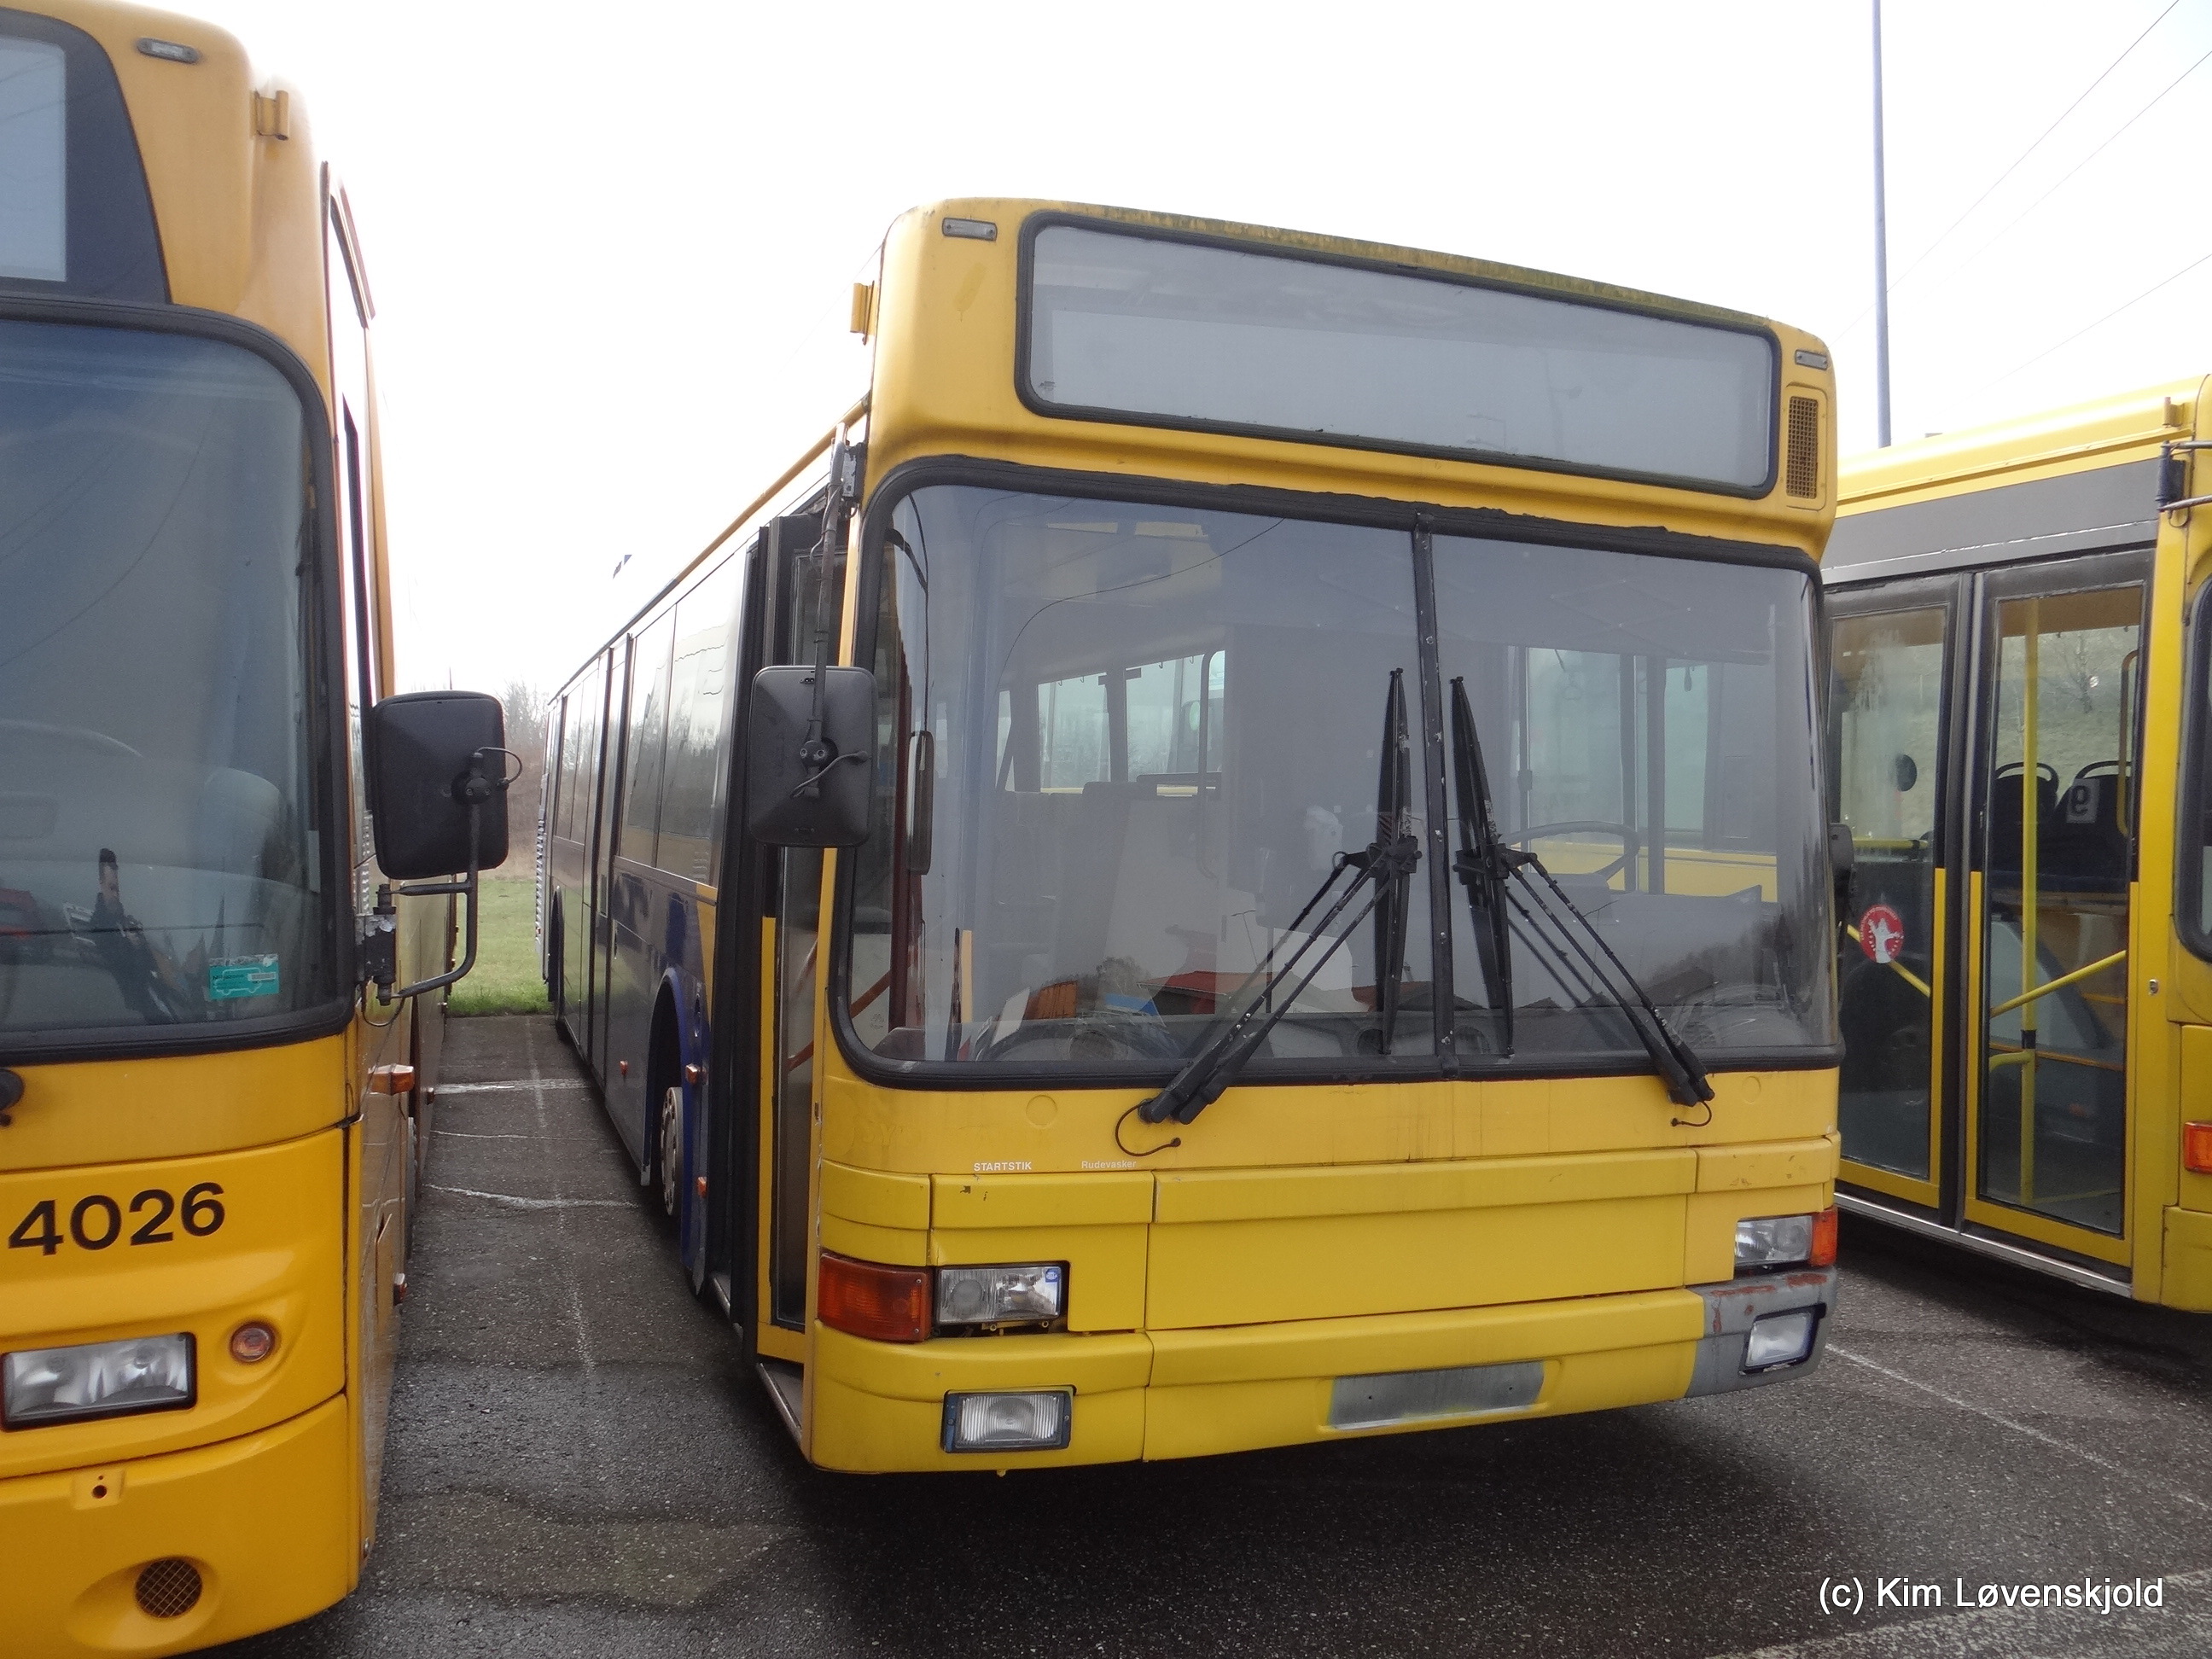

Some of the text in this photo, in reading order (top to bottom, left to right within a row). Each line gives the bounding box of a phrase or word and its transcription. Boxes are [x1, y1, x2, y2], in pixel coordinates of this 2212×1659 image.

[973, 1161, 1033, 1172] STARTSTIK
[1080, 1160, 1137, 1170] Rudevasker
[7, 1182, 226, 1256] 4026
